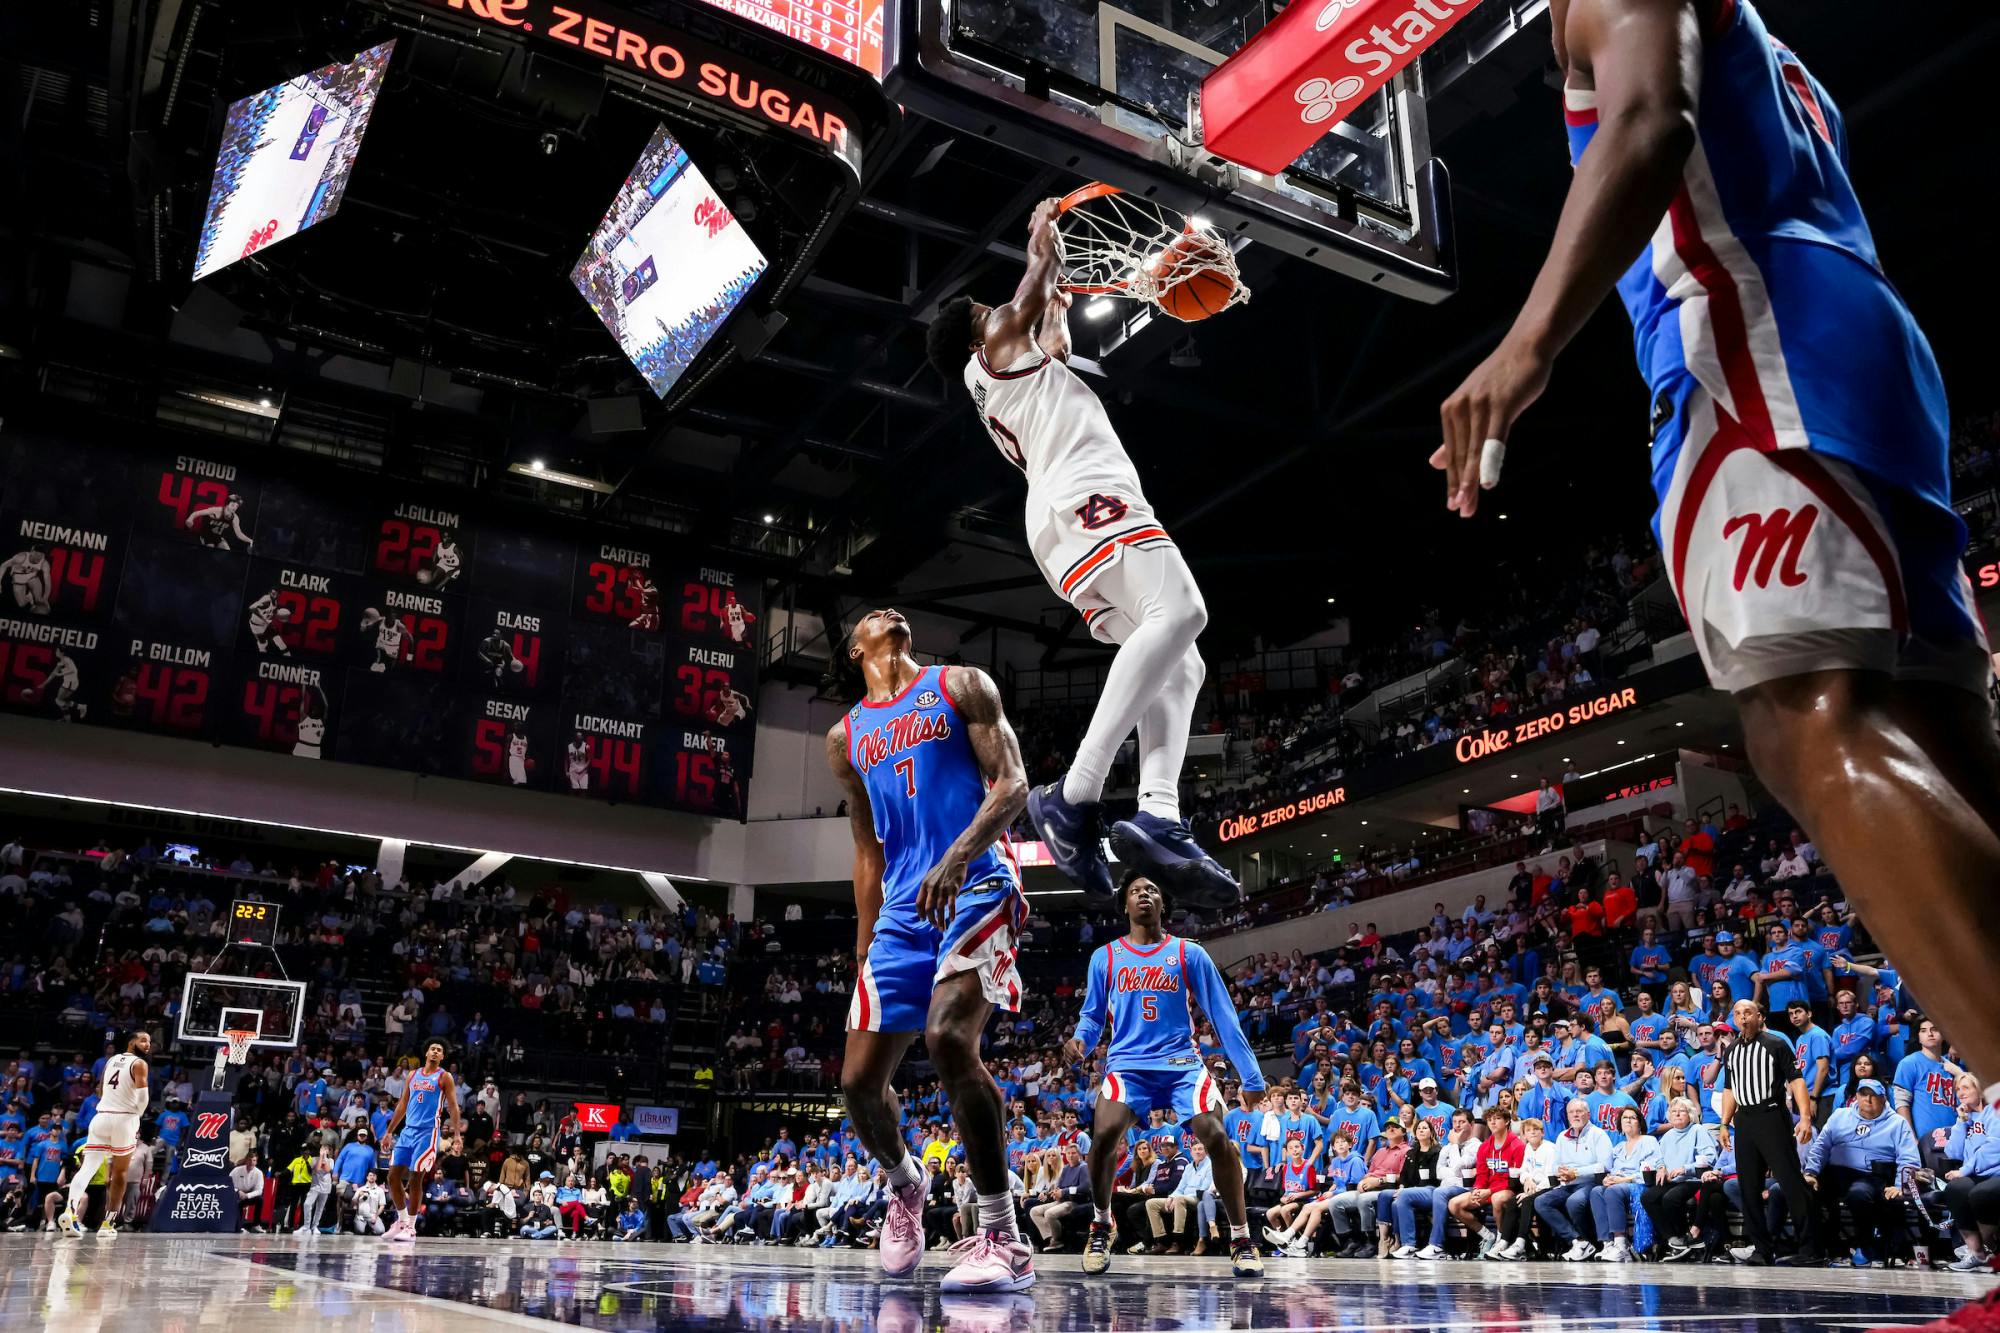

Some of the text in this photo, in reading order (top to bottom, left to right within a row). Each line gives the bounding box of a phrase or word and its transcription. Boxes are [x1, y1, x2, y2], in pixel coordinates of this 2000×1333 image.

[1344, 0, 1471, 76] Stat
[548, 5, 686, 79] ZERO
[697, 62, 849, 153] SUGAR
[175, 455, 237, 482] STROUD
[19, 519, 109, 551] NEUMANN
[1723, 503, 1819, 592] M
[600, 543, 651, 568] CARTER
[280, 569, 331, 593] CLARK
[699, 566, 736, 587] PRICE
[385, 589, 443, 615] BARNES
[496, 610, 541, 632] GLASS
[130, 639, 212, 669] P. GILLOM
[688, 646, 735, 668] FALERU
[258, 661, 321, 687] CONNER
[484, 700, 531, 722] SESAY
[917, 691, 936, 705] SEC
[574, 712, 645, 739] LOCKHART
[1455, 687, 1637, 764] Coke ZERO SUGAR
[471, 718, 506, 777] 5
[682, 731, 727, 752] BAKER
[856, 709, 952, 776] Ole Miss
[893, 755, 917, 799] 7
[1219, 787, 1346, 842] Coke ZERO SUGAR
[1117, 965, 1179, 993] Ole Miss
[1141, 995, 1158, 1022] 5
[108, 1069, 121, 1090] 4
[189, 1153, 222, 1163] SONIC
[1487, 1159, 1509, 1170] SIP
[176, 1201, 220, 1211] RIVER
[179, 1192, 219, 1202] PEARL
[170, 1210, 224, 1220] RESORT
